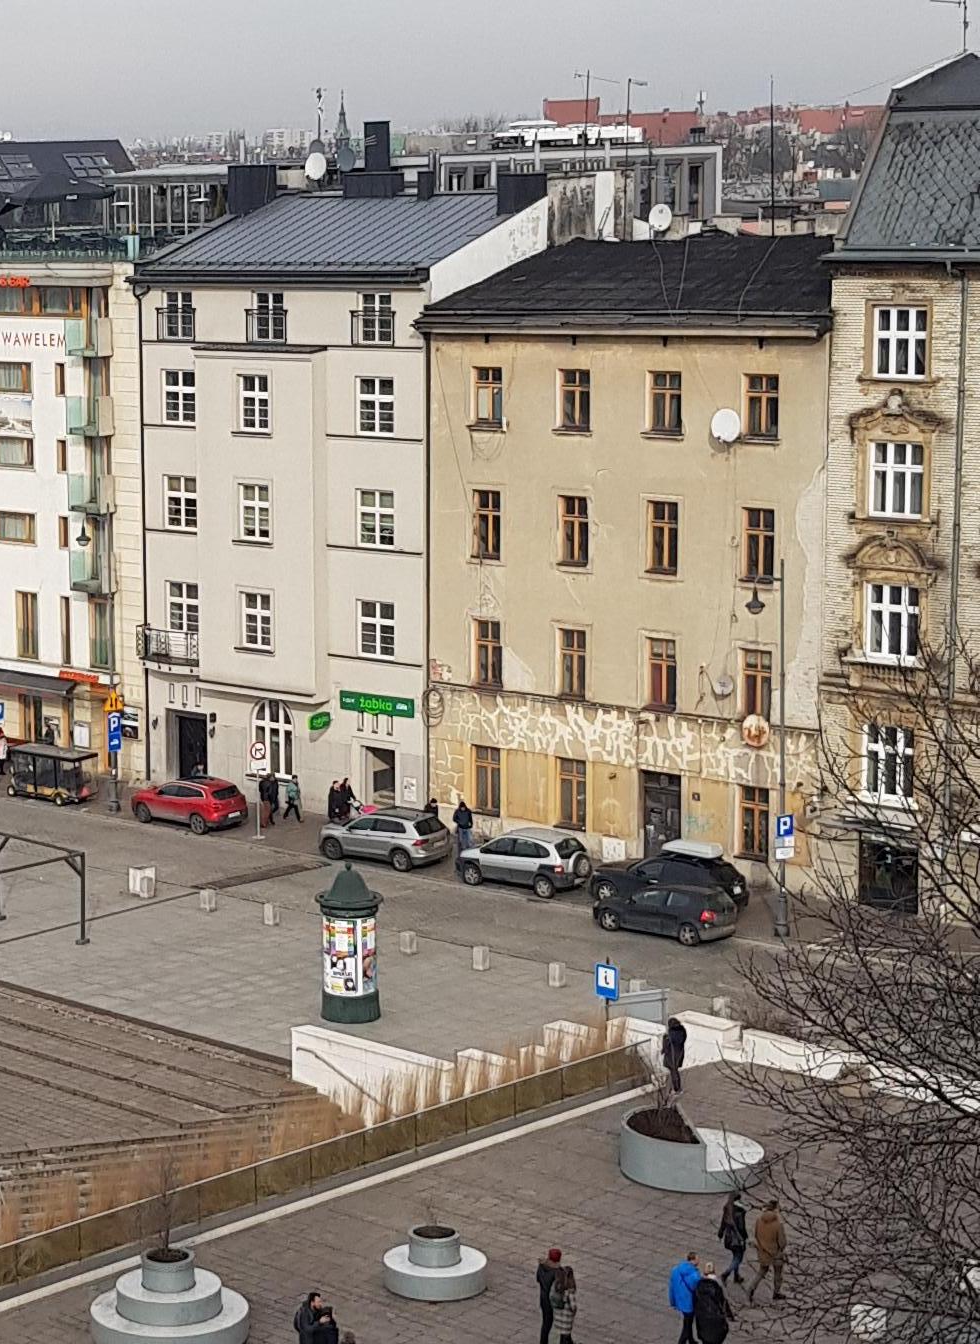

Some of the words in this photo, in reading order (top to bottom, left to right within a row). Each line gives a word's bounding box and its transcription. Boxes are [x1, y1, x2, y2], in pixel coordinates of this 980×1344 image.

[1, 331, 66, 347] WAWELEM
[360, 696, 393, 711] żabka
[110, 717, 119, 731] P
[780, 817, 790, 835] P
[604, 970, 610, 985] i
